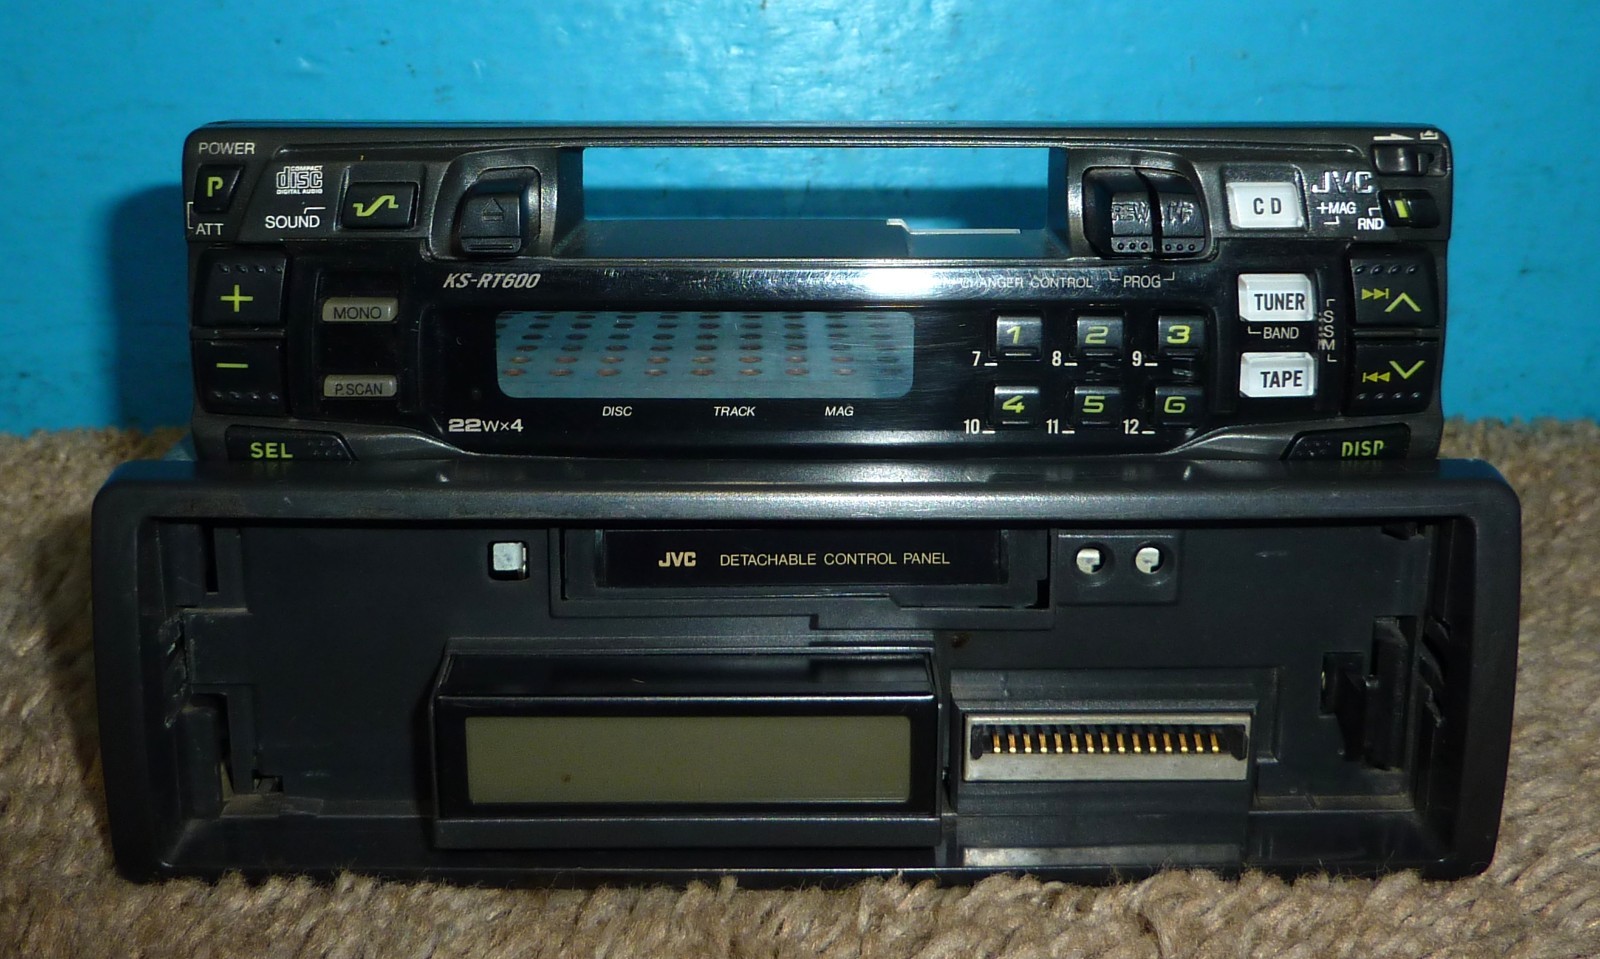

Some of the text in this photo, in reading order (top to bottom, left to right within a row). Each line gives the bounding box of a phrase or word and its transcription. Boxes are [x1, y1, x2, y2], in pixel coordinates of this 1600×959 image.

[198, 142, 255, 155] POWER
[207, 176, 223, 198] P
[1311, 171, 1373, 194] JVC
[195, 223, 224, 236] ATT
[264, 215, 321, 229] SOUND
[1357, 217, 1385, 230] RND
[442, 272, 541, 289] KS-RT600
[961, 276, 1093, 288] CHANGER CONTROL
[1123, 275, 1162, 289] PROG
[1254, 293, 1306, 311] TUNER
[333, 306, 382, 320] MONO
[1006, 325, 1022, 344] 1
[1085, 326, 1109, 344] 2
[1166, 325, 1191, 344] 3
[1263, 326, 1299, 340] BAND
[971, 351, 981, 366] 7
[1051, 351, 1062, 366] 8
[1131, 351, 1142, 367] 9
[1260, 370, 1304, 388] TAPE
[334, 383, 383, 395] P.SCAN
[602, 405, 633, 417] DISC
[714, 405, 756, 417] TRACK
[824, 405, 855, 417] MAG
[1001, 395, 1025, 413] 4
[1082, 396, 1105, 414] 5
[964, 419, 980, 434] 10
[1046, 419, 1059, 433] 11
[1123, 419, 1140, 434] 12
[250, 442, 293, 459] SEL
[1341, 440, 1385, 457] DISP
[658, 551, 697, 568] JVC
[720, 552, 950, 566] DETACHABLE CONTROL PANEL
